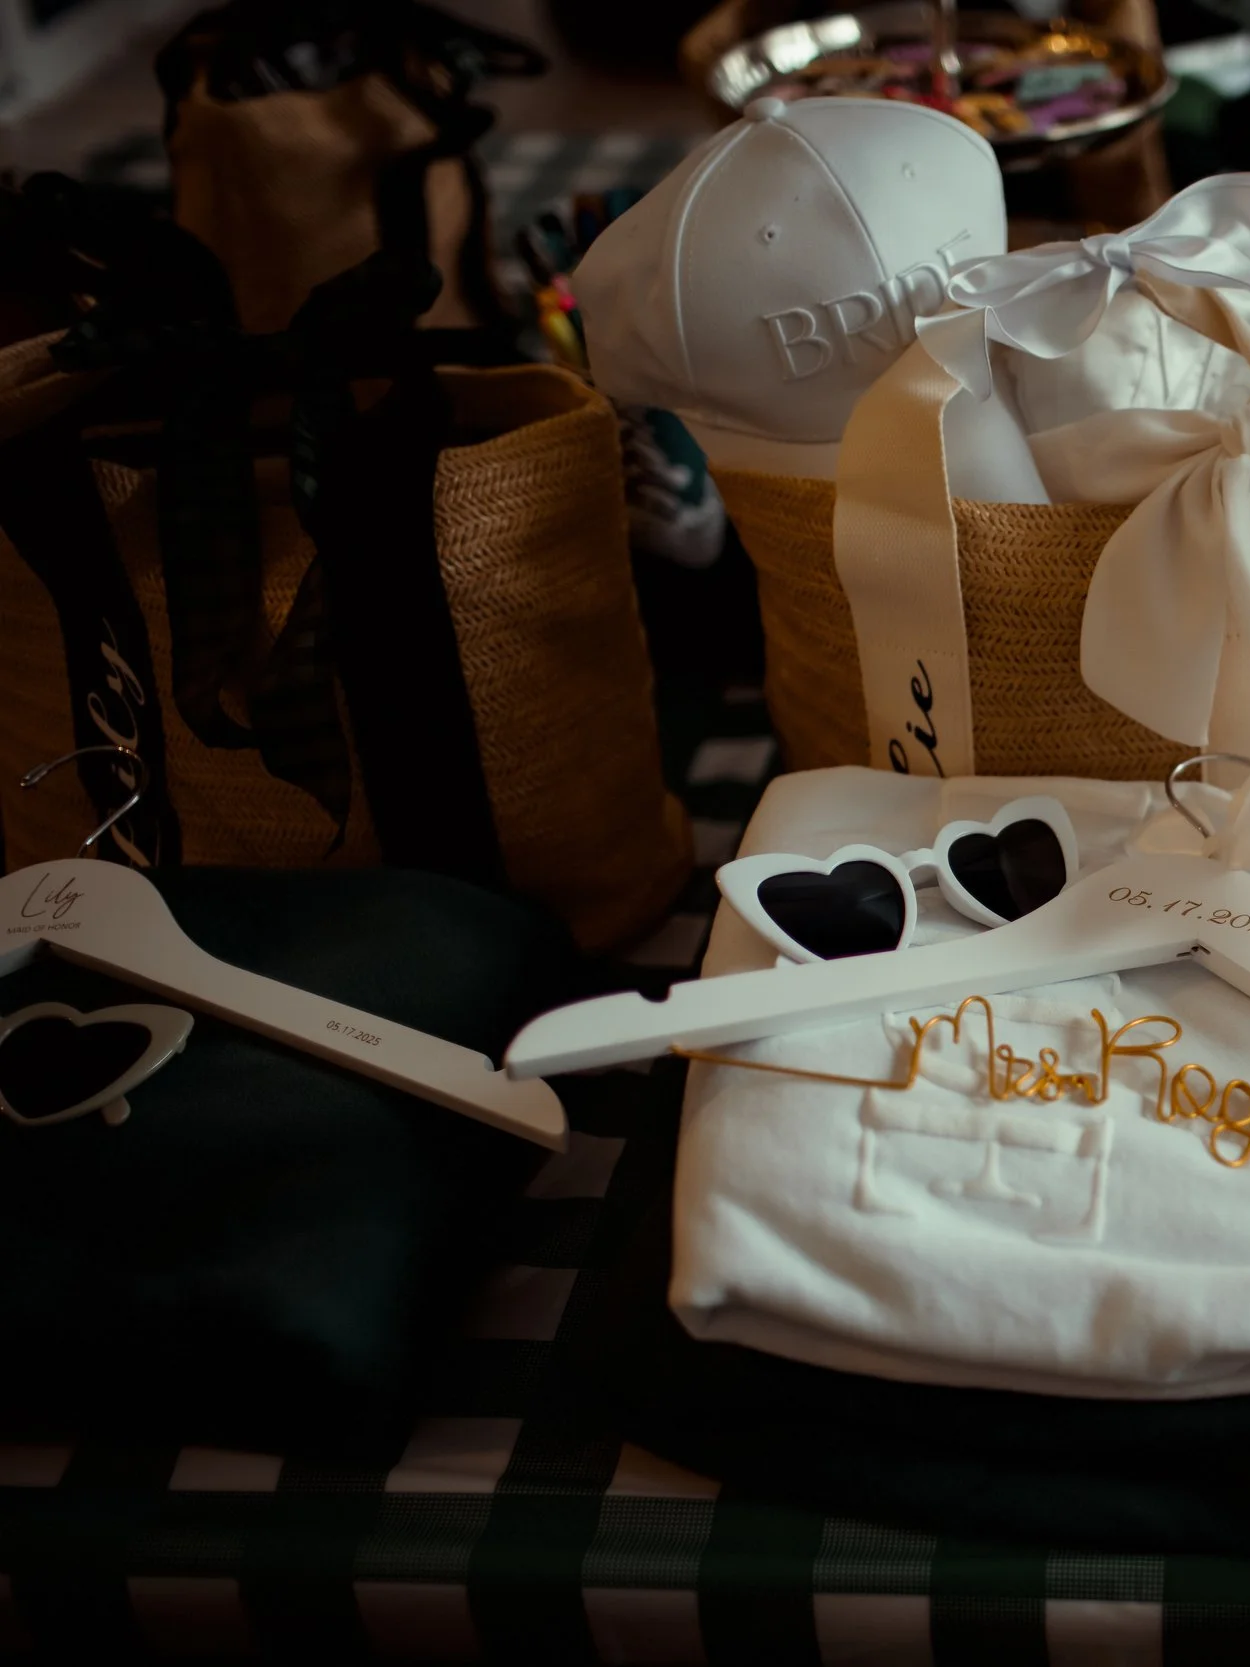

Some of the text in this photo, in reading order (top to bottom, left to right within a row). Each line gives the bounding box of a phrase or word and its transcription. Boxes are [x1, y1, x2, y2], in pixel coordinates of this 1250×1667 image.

[762, 228, 972, 382] BRID
[21, 873, 85, 919] Lily
[326, 1020, 382, 1046] 05.17.2025
